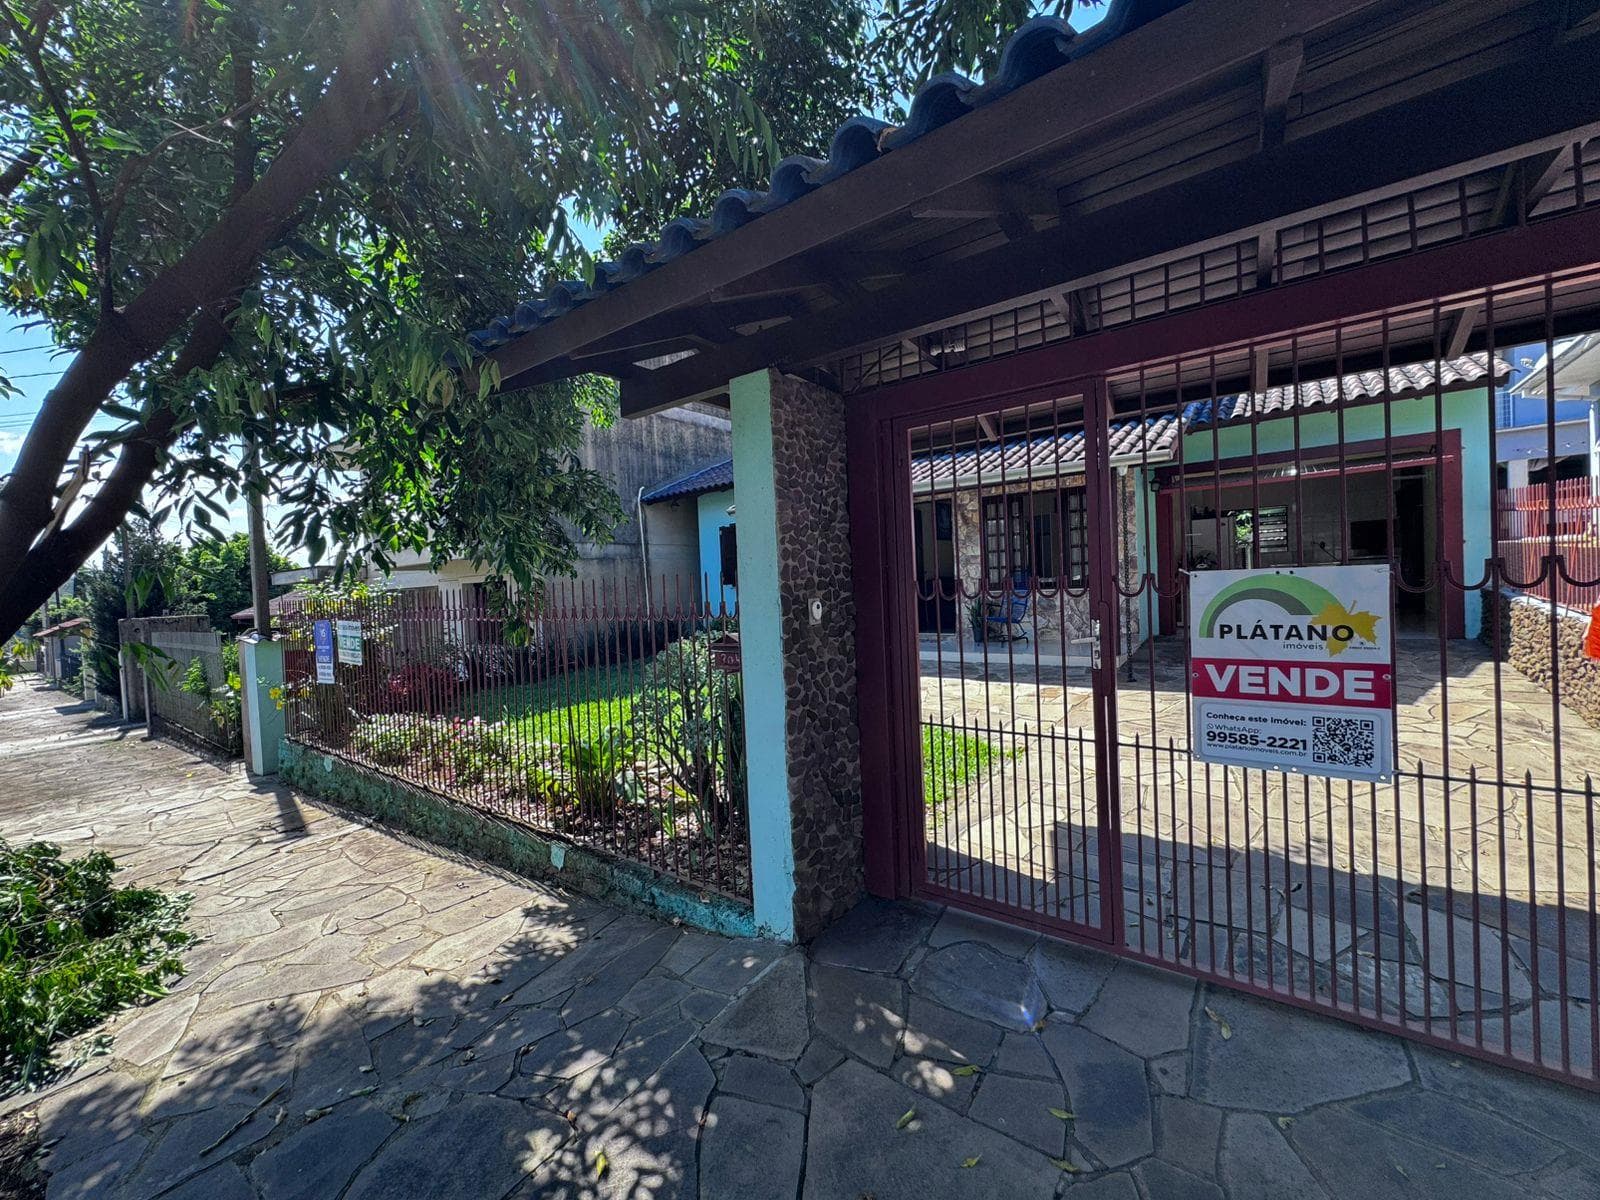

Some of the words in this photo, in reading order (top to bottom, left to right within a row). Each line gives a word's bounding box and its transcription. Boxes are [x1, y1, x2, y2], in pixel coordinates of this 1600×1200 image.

[1219, 620, 1354, 641] PLÁTANO
[1283, 641, 1323, 651] imóveis
[1204, 664, 1375, 701] VENDE
[1206, 711, 1246, 722] Conheça
[1215, 724, 1262, 735] WhatsApp:
[1206, 730, 1307, 751] 99585-2221
[1207, 743, 1307, 757] www.platanoimoveis.com.br
